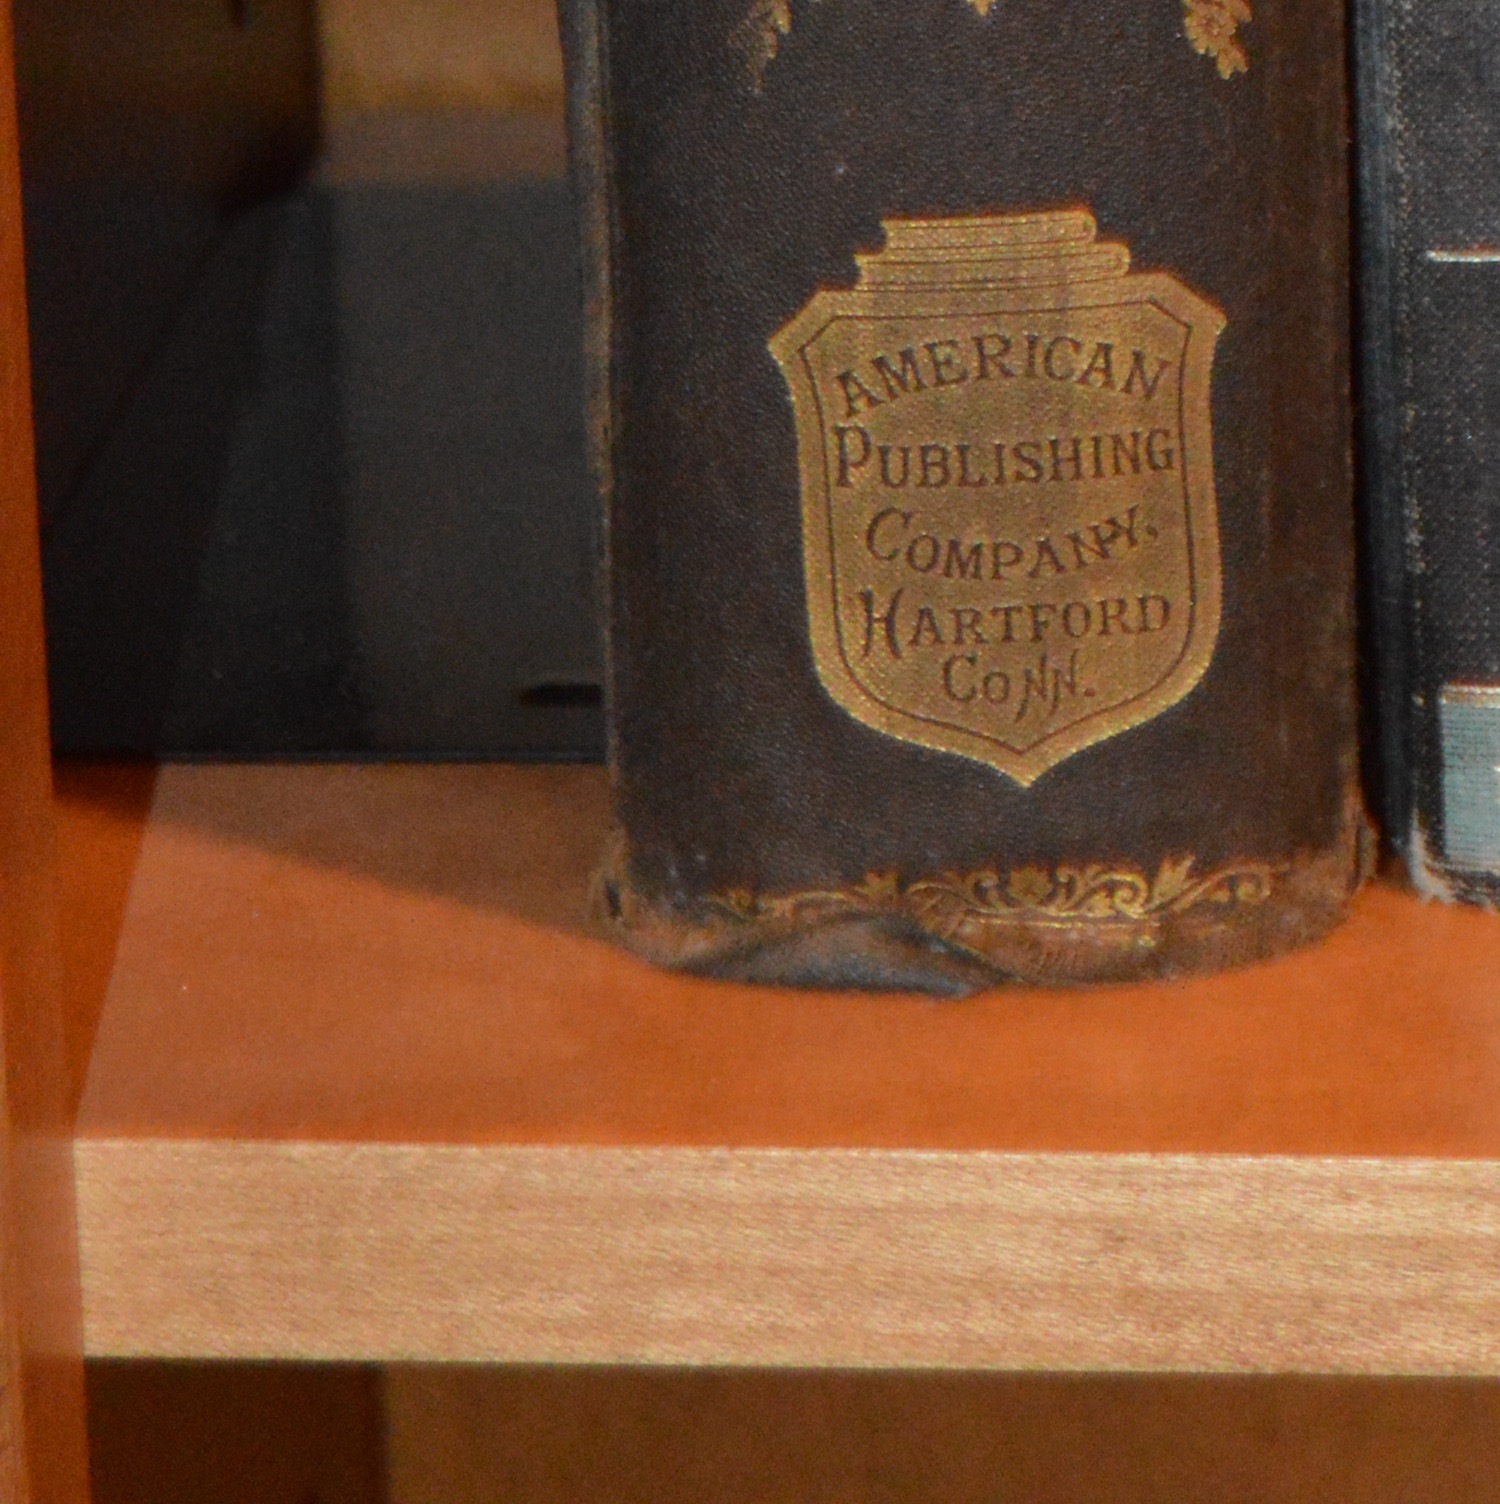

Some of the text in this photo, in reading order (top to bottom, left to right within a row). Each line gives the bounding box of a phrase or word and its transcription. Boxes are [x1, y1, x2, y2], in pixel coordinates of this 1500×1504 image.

[834, 332, 1174, 419] AMERICAN
[832, 424, 1177, 490] PUBLISHING
[861, 588, 1172, 661] HARTFORD
